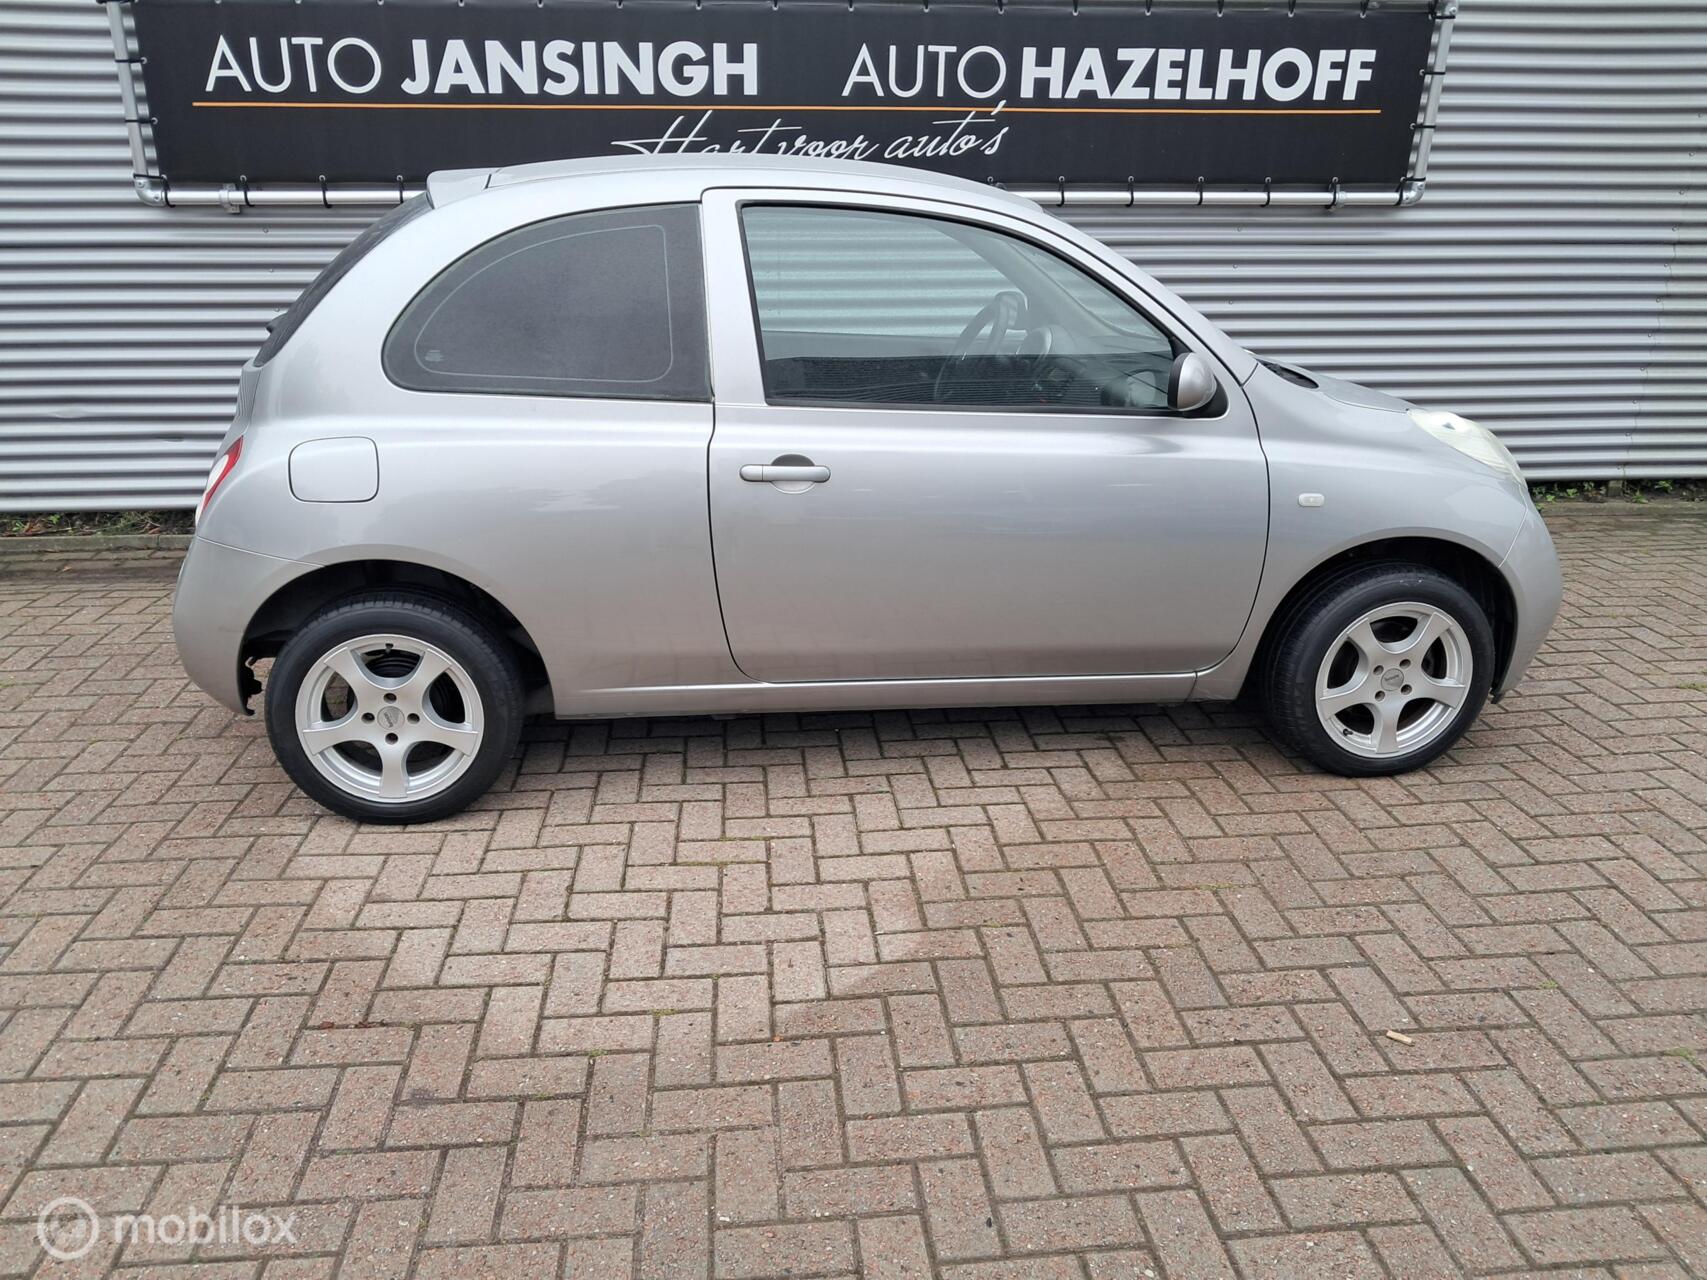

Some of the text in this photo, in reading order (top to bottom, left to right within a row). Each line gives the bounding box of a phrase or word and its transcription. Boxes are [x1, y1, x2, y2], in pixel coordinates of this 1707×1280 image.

[206, 35, 757, 96] AUTO JANSINGH
[842, 43, 1376, 101] AUTO HAZELHOFF
[884, 100, 1009, 159] auto's
